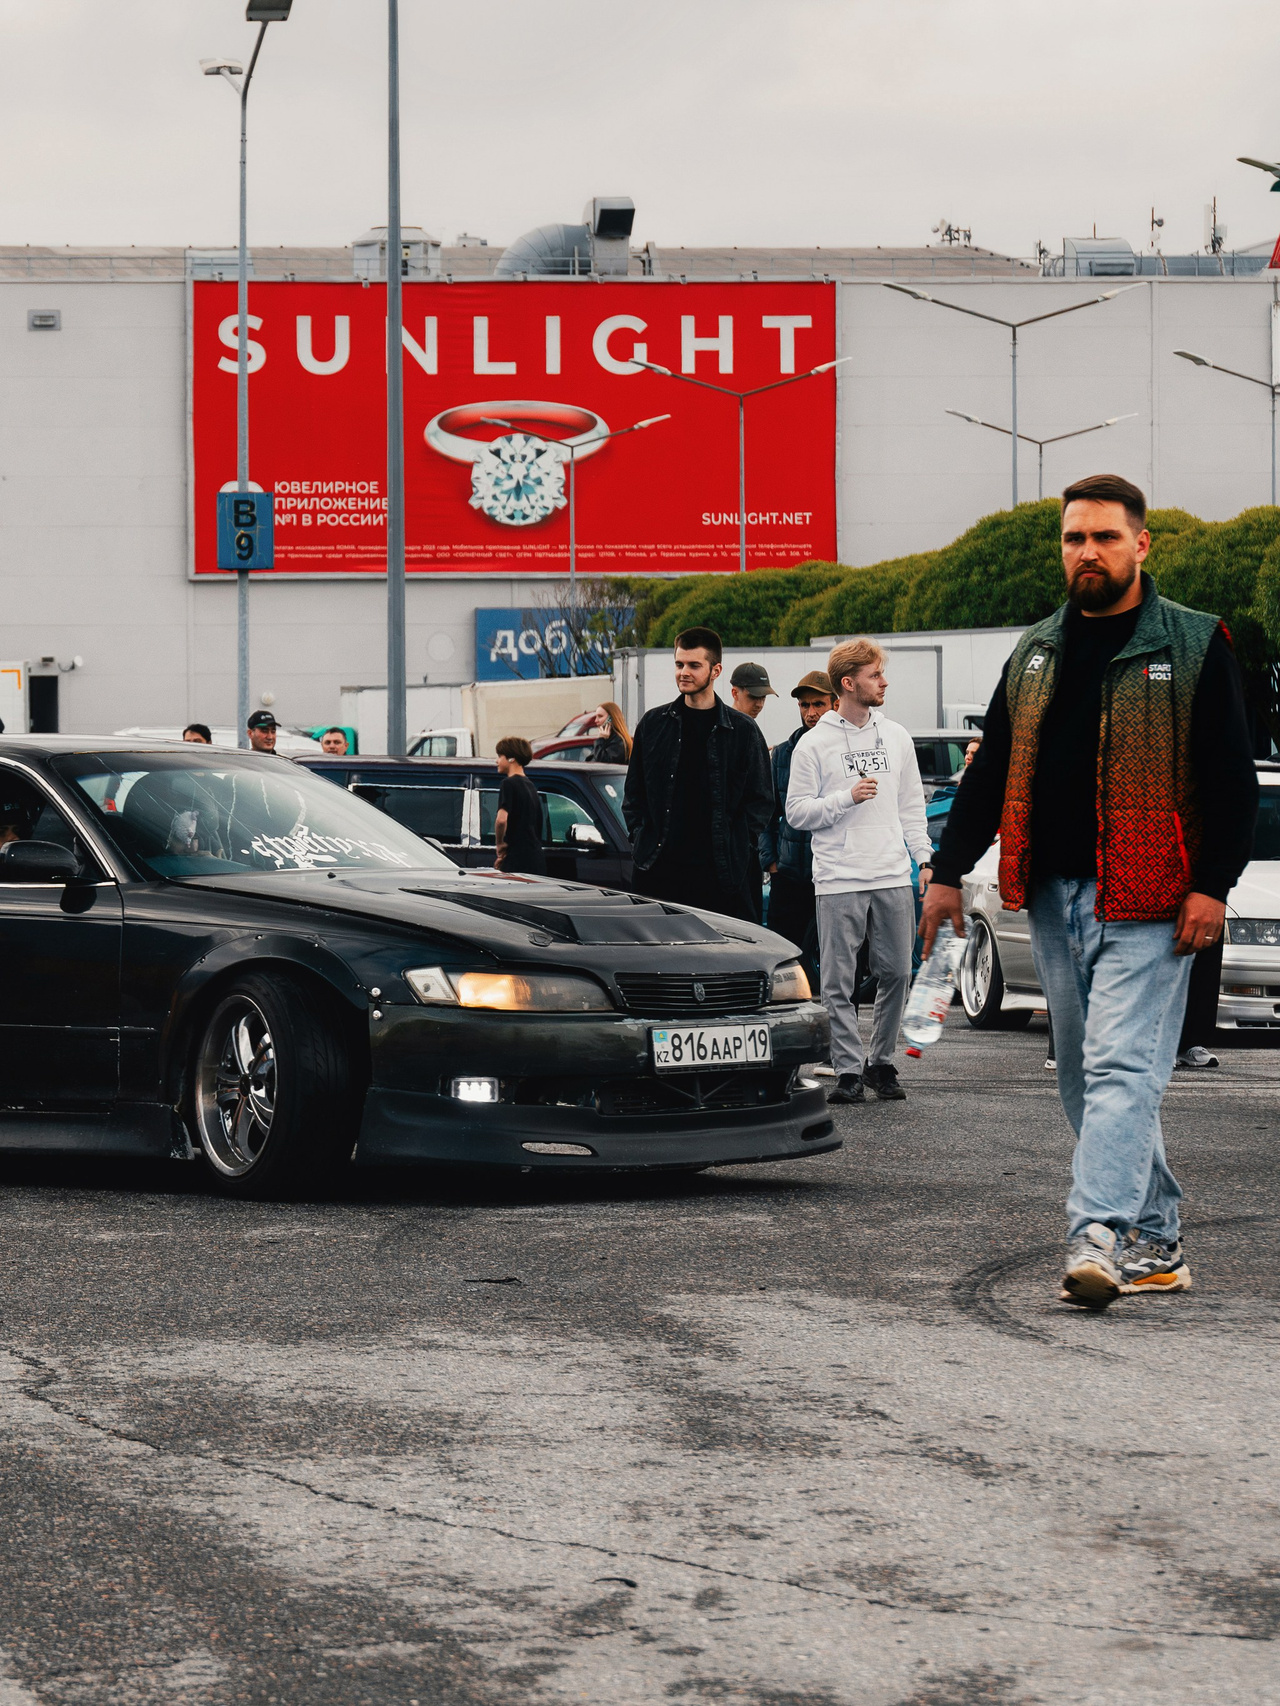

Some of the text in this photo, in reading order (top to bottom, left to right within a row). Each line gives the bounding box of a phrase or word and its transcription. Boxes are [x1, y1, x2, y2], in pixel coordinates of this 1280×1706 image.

[217, 314, 812, 376] SUNLIGHT
[274, 481, 379, 494] ЮВЕЛИРНОЕ
[274, 497, 389, 510] ПРИЛОЖЕНИЕ
[302, 513, 312, 526] В
[702, 512, 812, 525] SUNLIGHT.NET
[235, 532, 254, 560] 9
[490, 619, 618, 663] добо
[1148, 672, 1172, 680] VOLT
[656, 1051, 669, 1062] KZ
